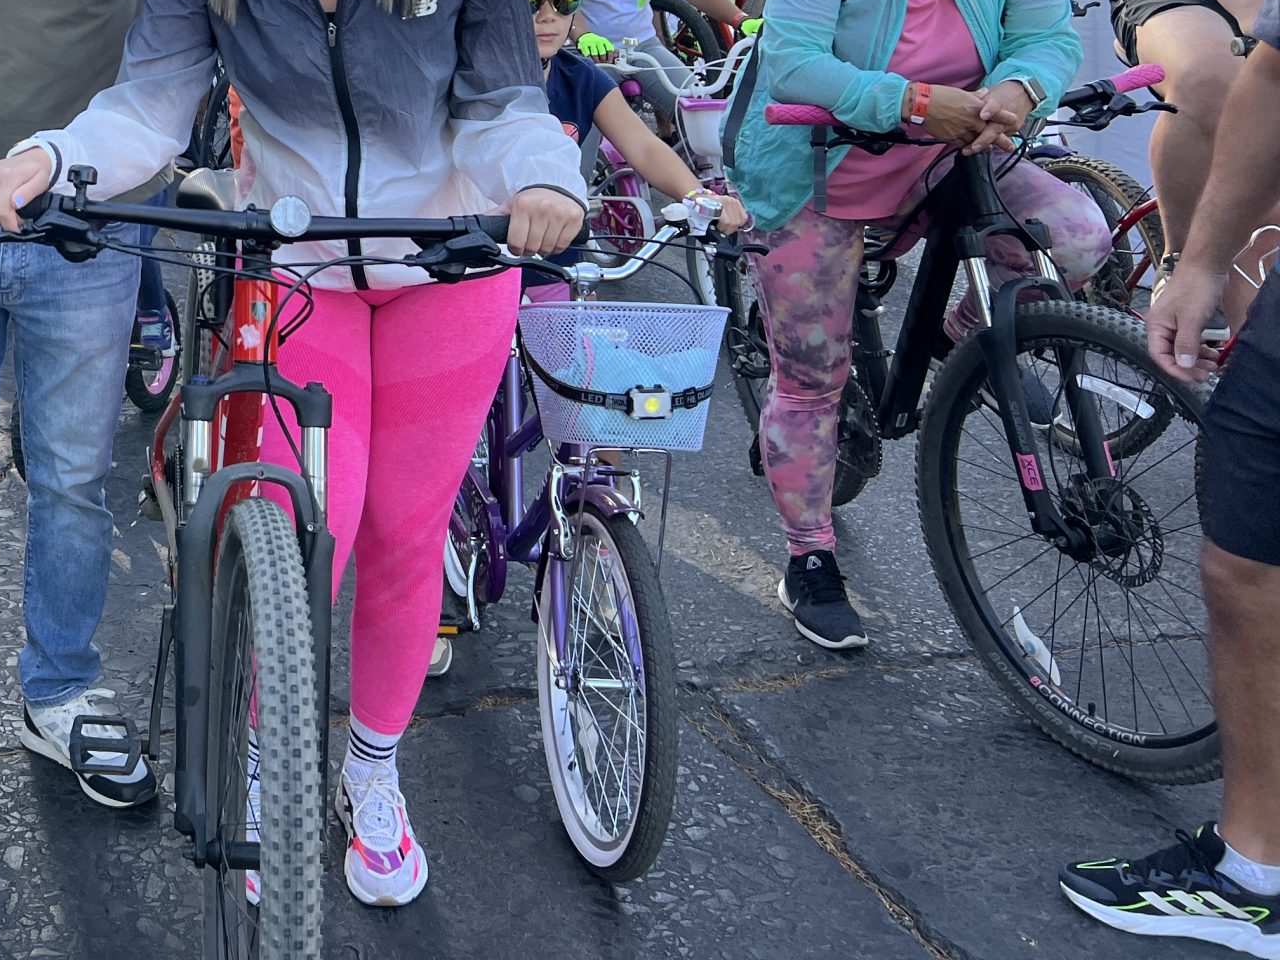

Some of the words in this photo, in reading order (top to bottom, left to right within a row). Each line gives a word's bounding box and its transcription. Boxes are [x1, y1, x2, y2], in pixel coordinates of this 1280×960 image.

[580, 393, 604, 404] LED
[1023, 459, 1041, 486] XCE
[988, 652, 1063, 727] BONTRAGER
[1038, 684, 1147, 745] CONNECTION
